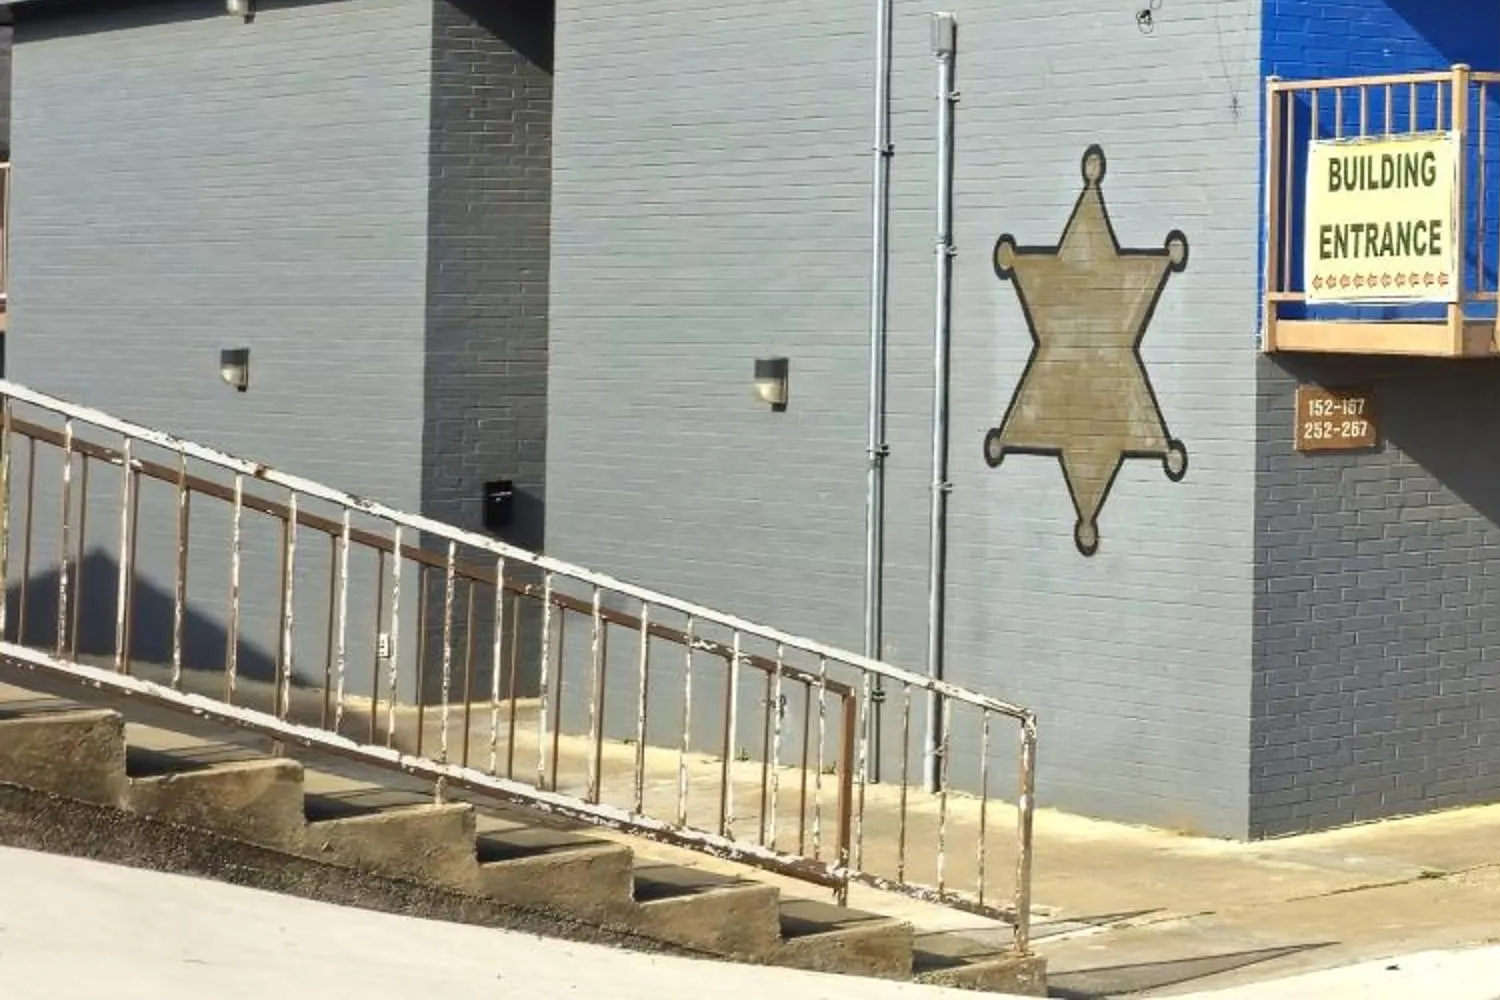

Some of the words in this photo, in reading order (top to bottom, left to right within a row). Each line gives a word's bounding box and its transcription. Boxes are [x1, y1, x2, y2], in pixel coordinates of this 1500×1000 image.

[1328, 151, 1437, 192] BUILDING
[1319, 219, 1442, 260] ENTRANCE
[1303, 421, 1368, 439] 252-267
